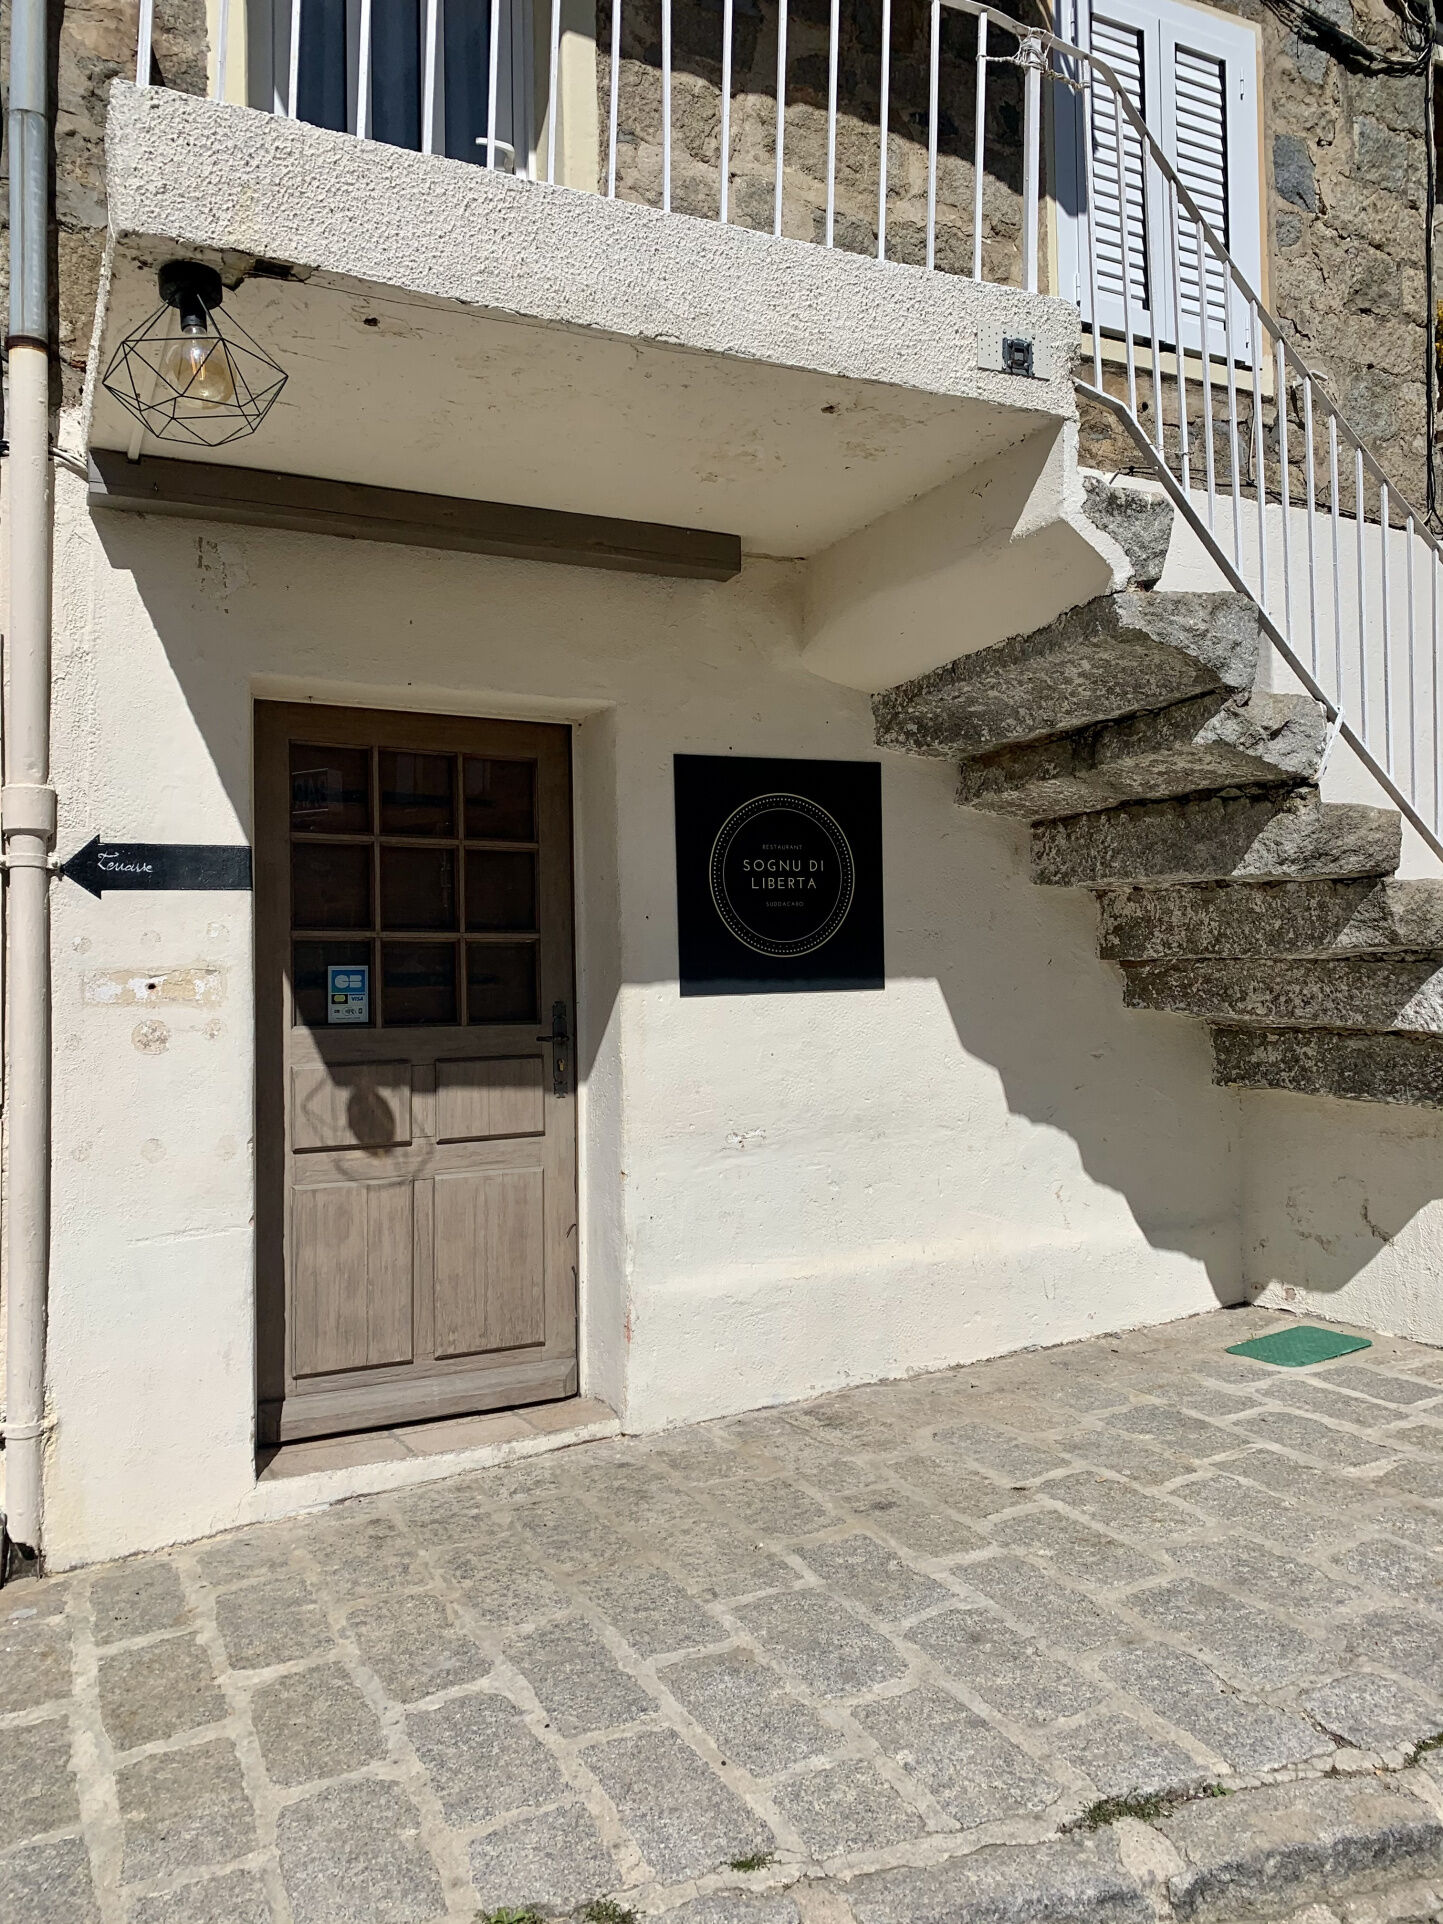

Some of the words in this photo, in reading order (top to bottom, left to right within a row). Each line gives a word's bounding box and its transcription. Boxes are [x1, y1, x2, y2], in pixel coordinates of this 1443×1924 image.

[743, 859, 801, 872] SOGNU
[809, 859, 824, 872] DI
[751, 877, 817, 889] LIBERTA
